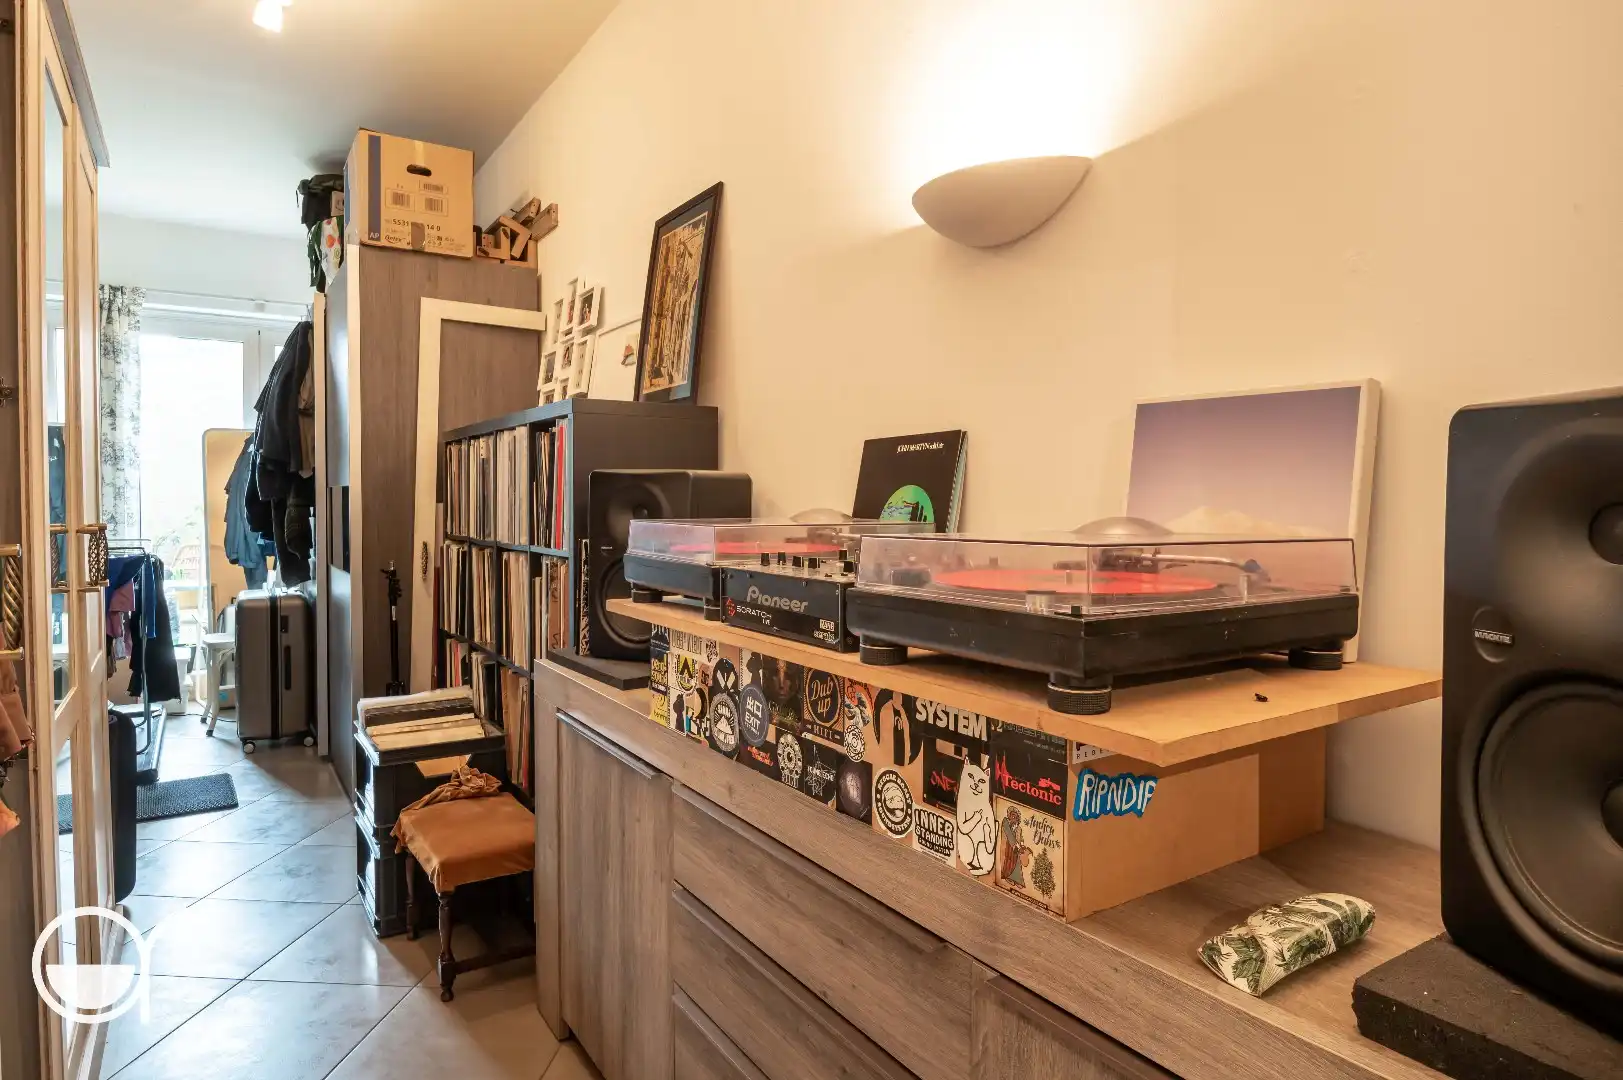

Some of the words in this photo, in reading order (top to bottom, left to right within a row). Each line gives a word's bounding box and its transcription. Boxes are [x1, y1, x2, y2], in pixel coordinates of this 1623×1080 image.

[370, 231, 380, 239] AP
[747, 585, 808, 613] Pioneer
[736, 605, 772, 620] SCRATCH
[811, 677, 834, 701] Dub
[817, 697, 831, 719] up
[915, 698, 988, 742] SYSTEM
[745, 711, 761, 730] EXIT
[813, 724, 833, 739] HIFI
[1002, 774, 1062, 806] Tectonic
[1078, 773, 1157, 817] RIPNDIP
[914, 809, 954, 839] INNER
[915, 824, 954, 849] STANDING
